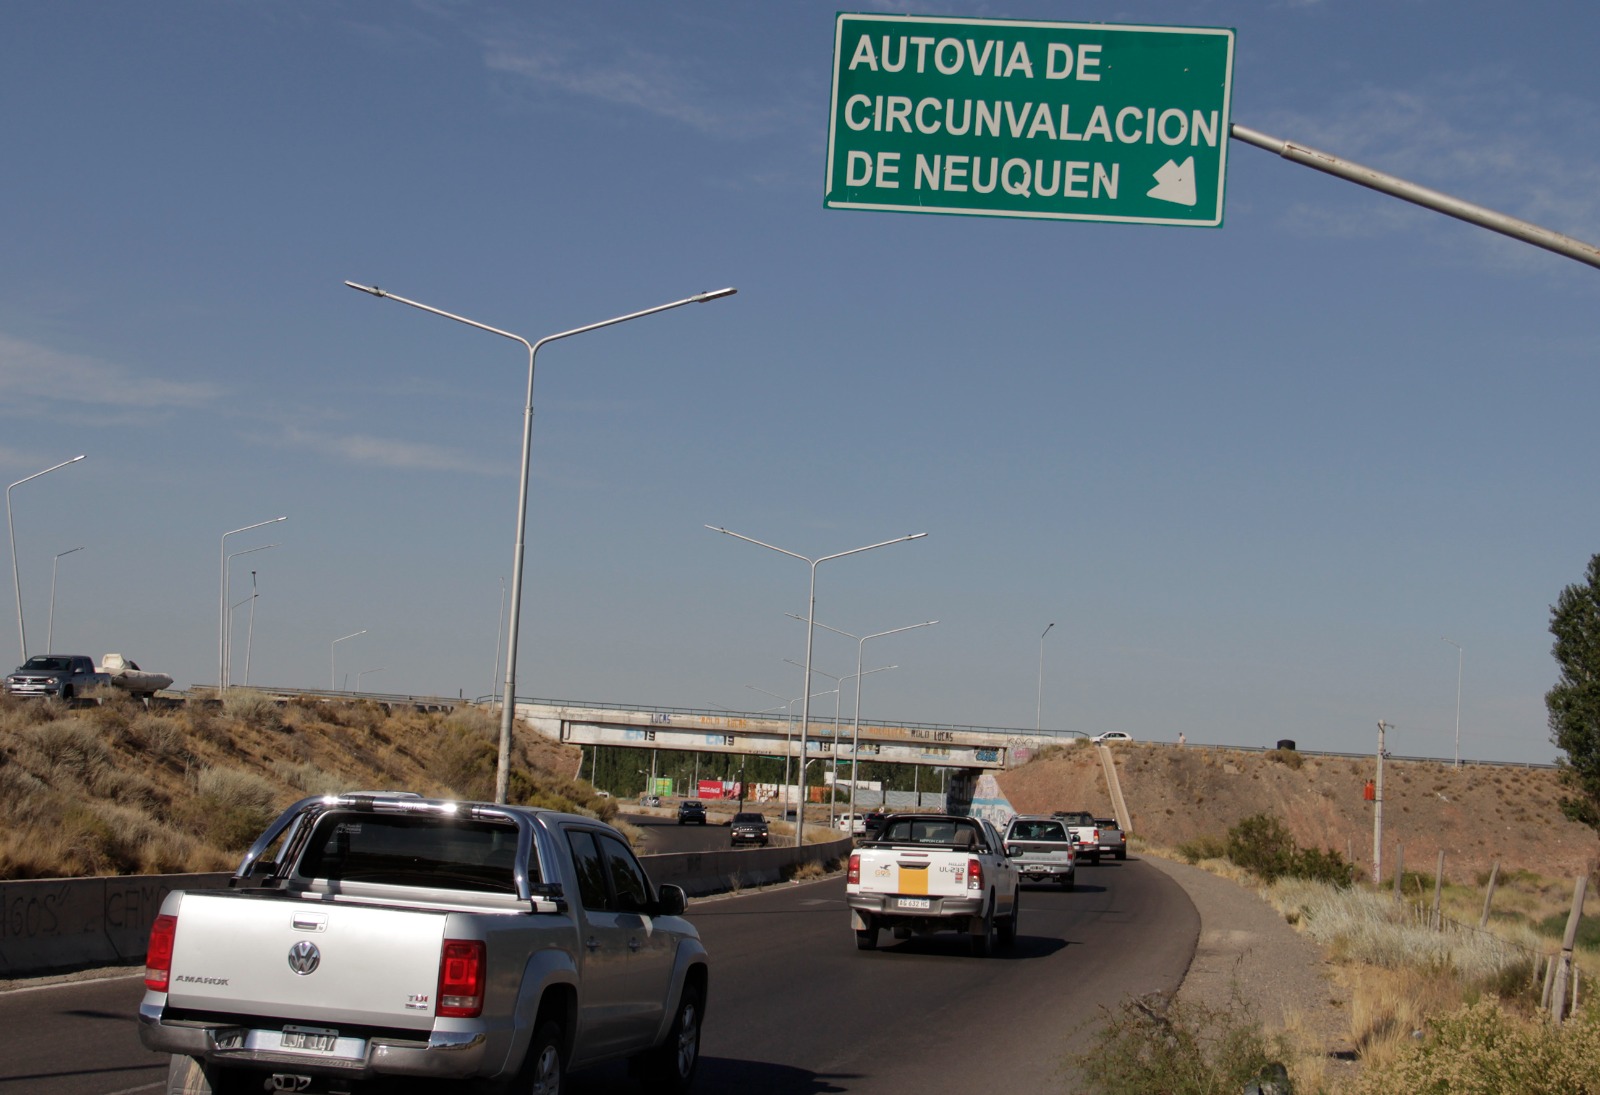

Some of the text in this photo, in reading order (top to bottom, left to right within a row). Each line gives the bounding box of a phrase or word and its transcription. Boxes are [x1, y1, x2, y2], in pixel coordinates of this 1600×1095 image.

[848, 34, 1103, 82] AUTOVIA DE
[844, 93, 1219, 148] CIRCUNVALACION
[845, 150, 1120, 199] DE NEUQUEN
[408, 994, 429, 1003] TDI
